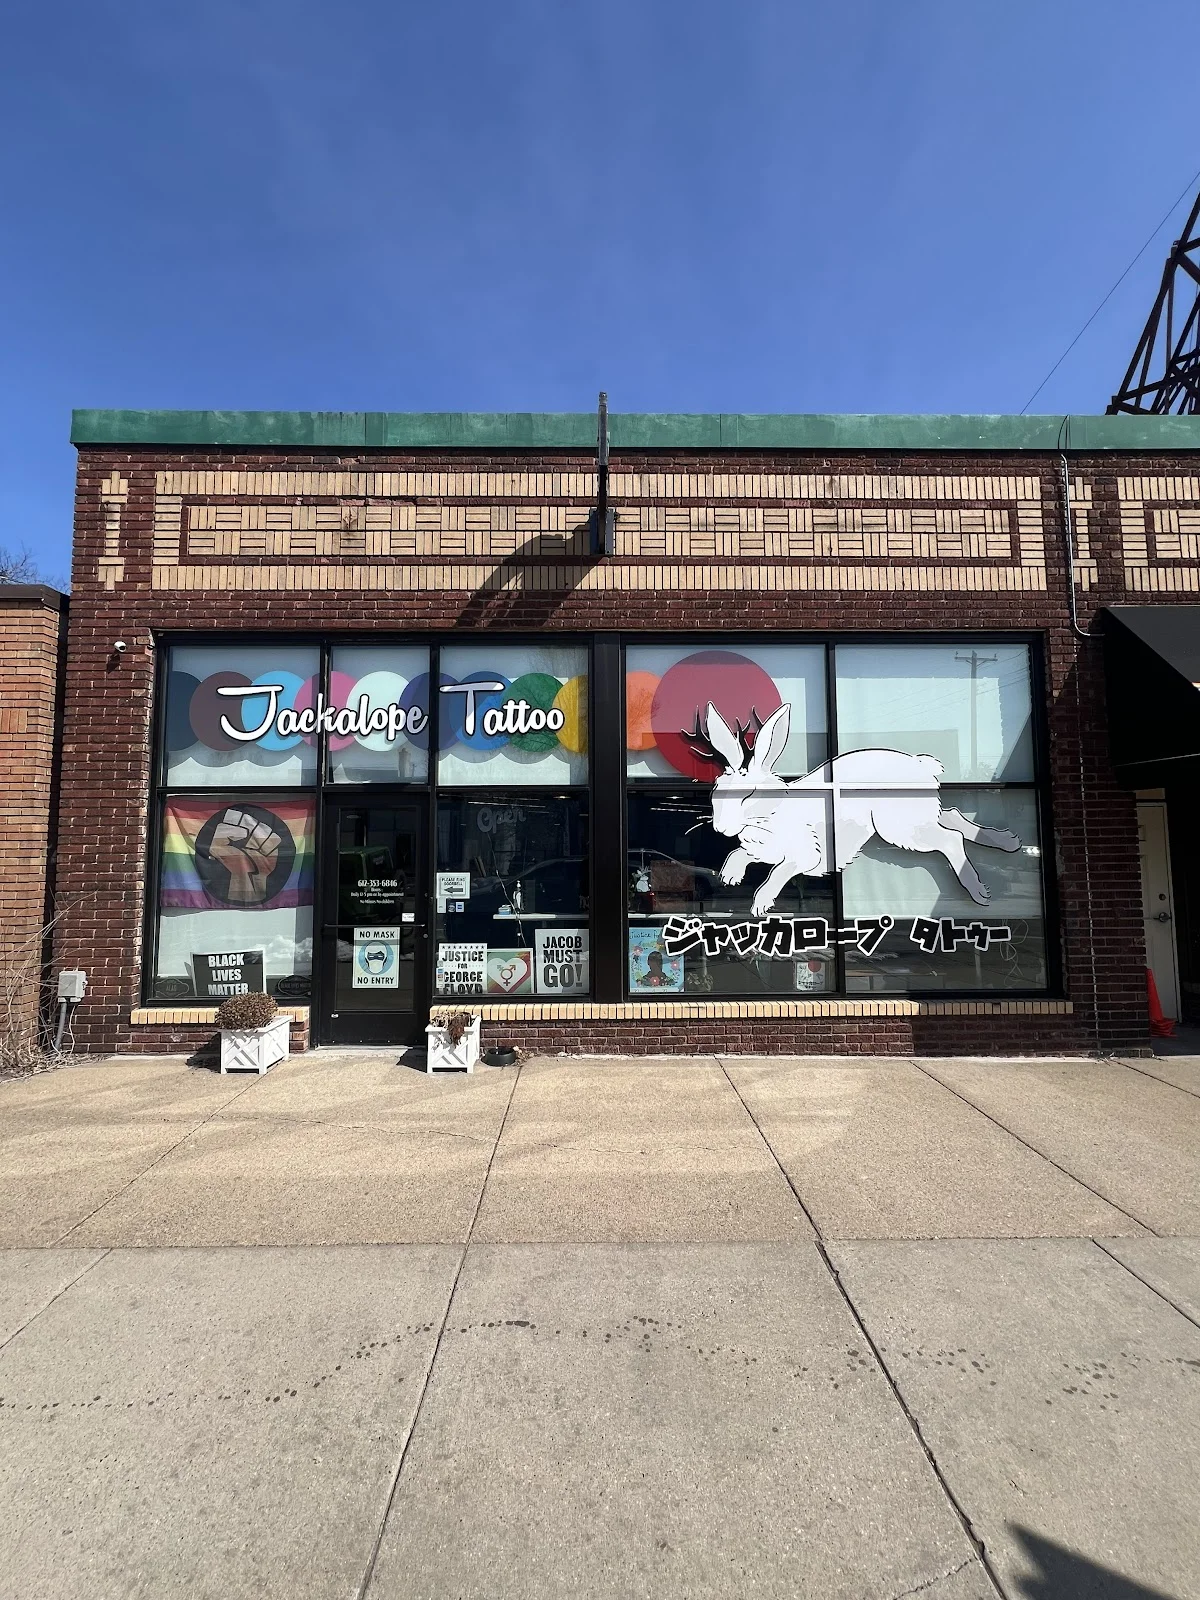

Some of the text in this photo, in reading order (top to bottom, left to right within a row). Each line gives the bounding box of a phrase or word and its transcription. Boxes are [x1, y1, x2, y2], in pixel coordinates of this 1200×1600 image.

[216, 682, 565, 742] Jackalope Tattoo
[477, 805, 527, 834] Open
[542, 935, 583, 949] JACOB
[662, 915, 1012, 956] ジャッカロープ タトゥー
[207, 953, 245, 967] BLACK
[441, 951, 484, 962] JUSTICE
[543, 950, 583, 963] MUST
[212, 968, 242, 982] LIVES
[444, 971, 483, 983] GEORGE
[543, 963, 583, 988] GO!
[207, 982, 249, 996] MATTER
[443, 983, 484, 994] FLOYD
